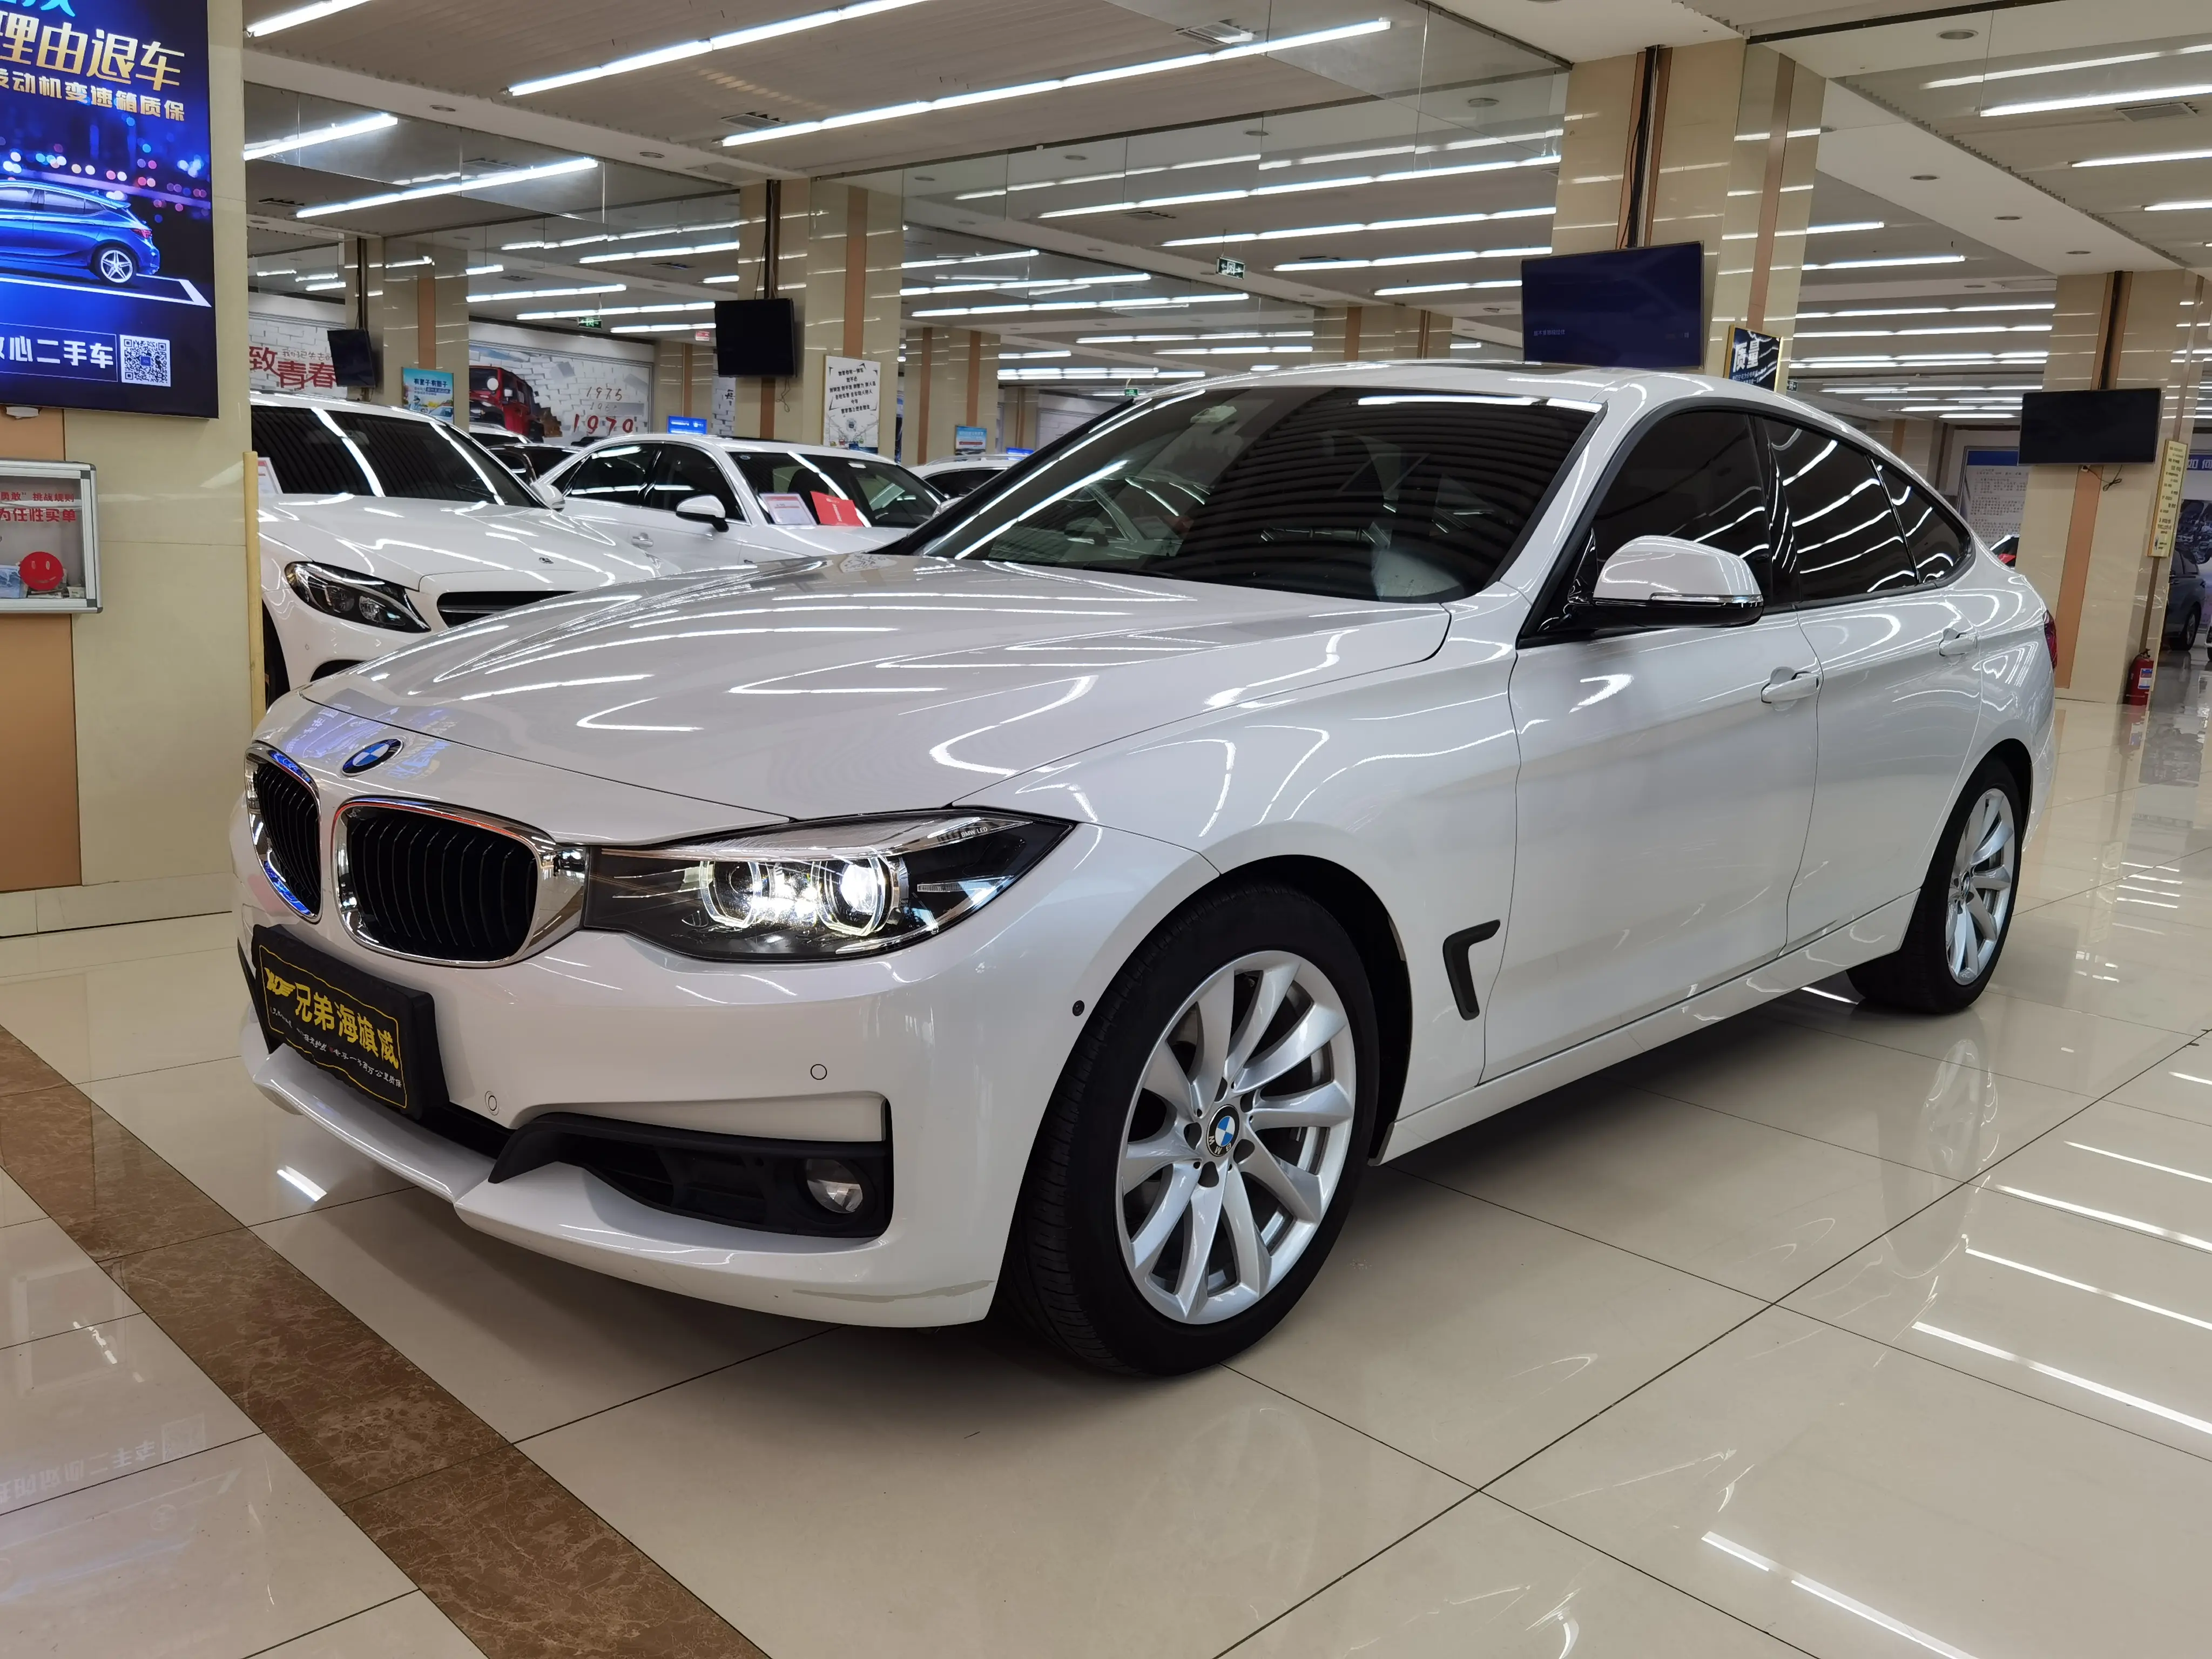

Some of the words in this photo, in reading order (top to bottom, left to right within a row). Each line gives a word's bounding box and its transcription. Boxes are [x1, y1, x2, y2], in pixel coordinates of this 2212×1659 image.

[0, 11, 185, 91] 理由退车
[0, 335, 113, 369] 心二手车
[1732, 339, 1760, 373] 质量
[249, 346, 336, 389] 致青春
[586, 387, 622, 401] 1975
[573, 414, 634, 436] 1970
[32, 492, 74, 502] 挑战规则
[0, 508, 76, 522] 为任性买单
[294, 981, 399, 1069] 兄弟海旗威
[1209, 1135, 1232, 1155] BMW
